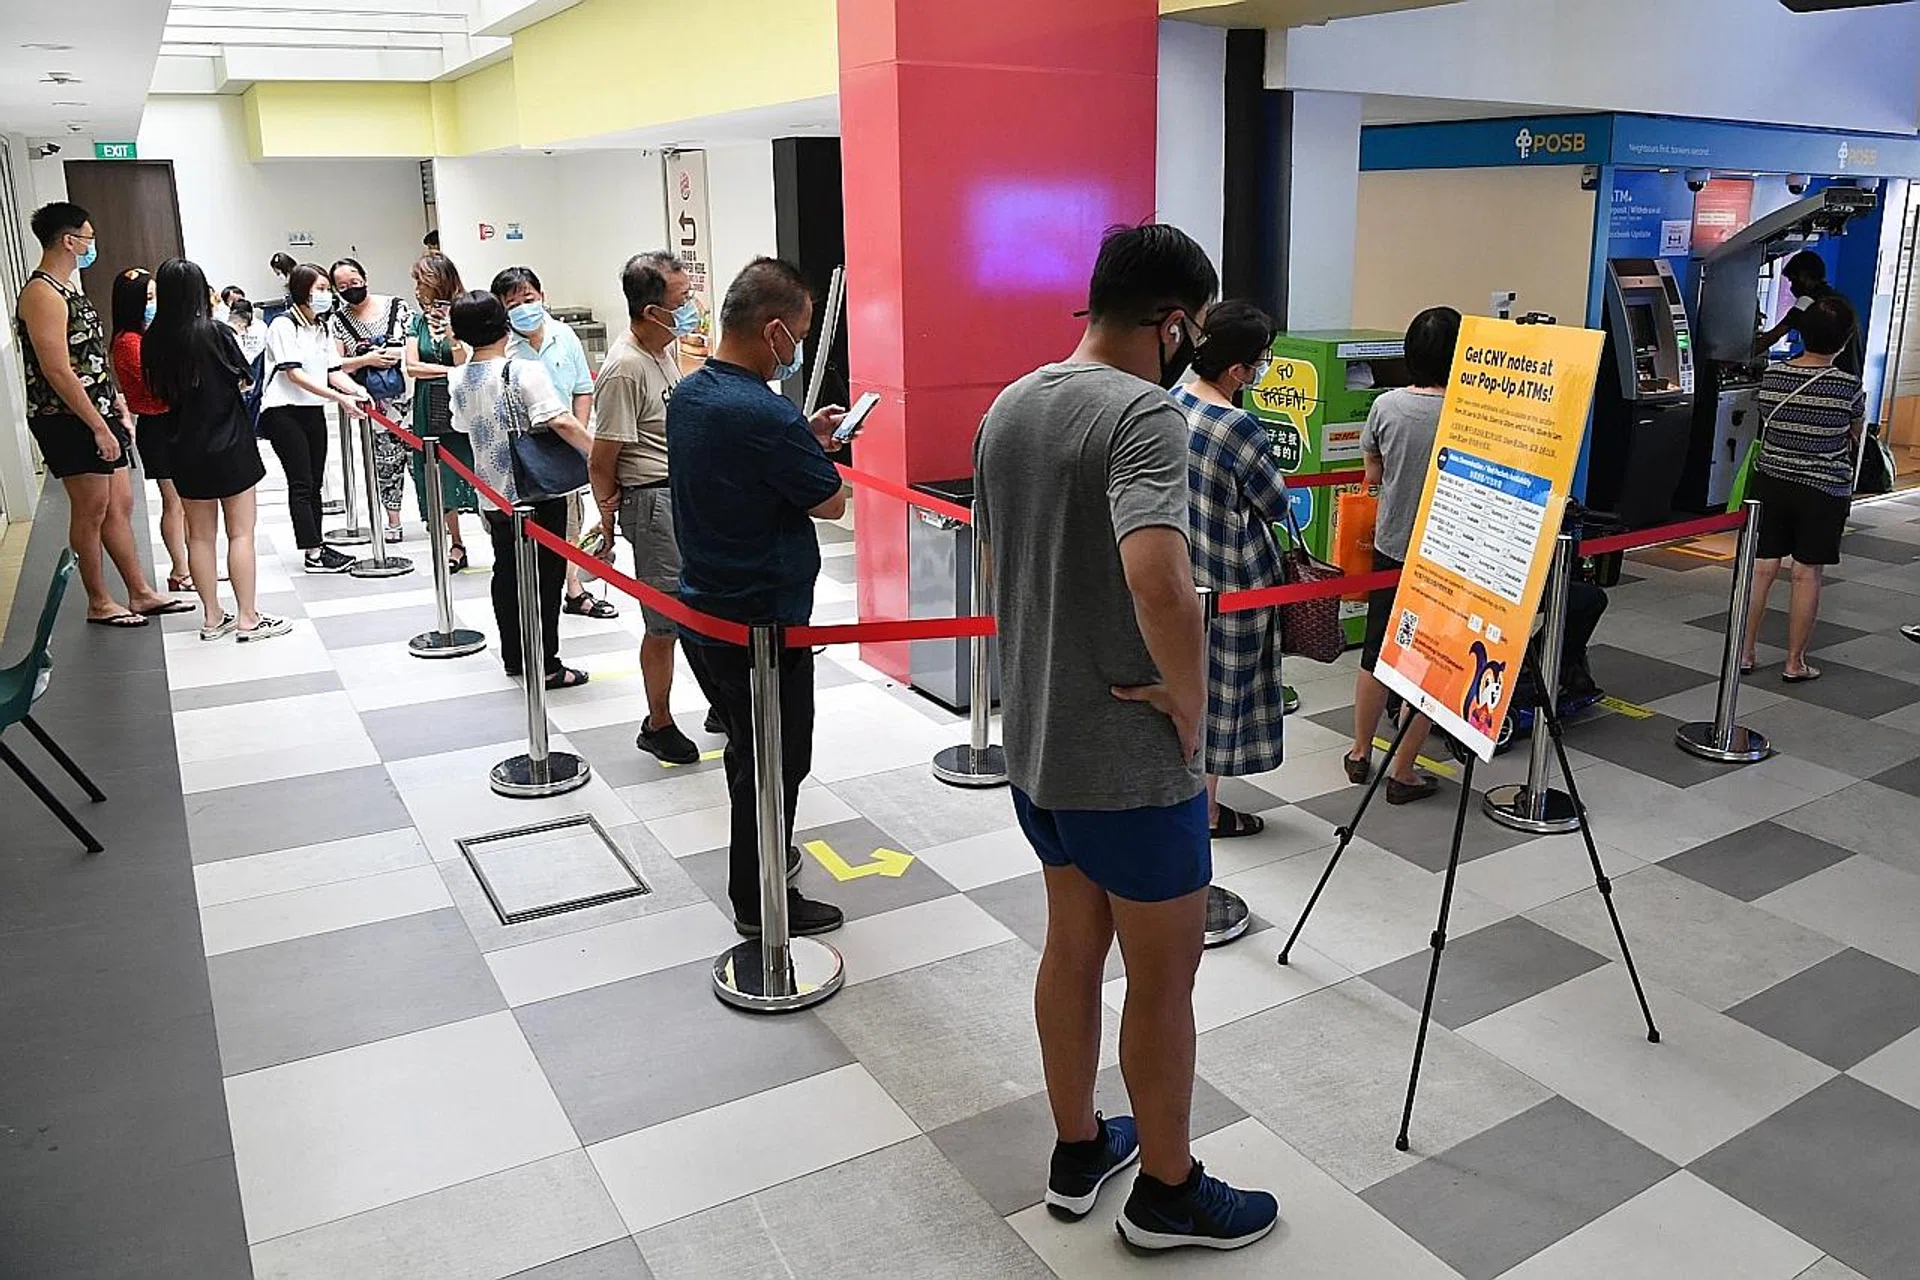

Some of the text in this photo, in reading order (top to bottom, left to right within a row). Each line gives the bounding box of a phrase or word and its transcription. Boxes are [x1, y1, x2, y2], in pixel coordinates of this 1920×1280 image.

[103, 144, 128, 157] EXIT
[1534, 133, 1585, 153] POSB
[1276, 363, 1294, 381] GO
[1465, 346, 1553, 376] Get CNY notes at
[1461, 372, 1554, 402] our Pop-Up ATMs!
[1260, 386, 1306, 411] GREEN!
